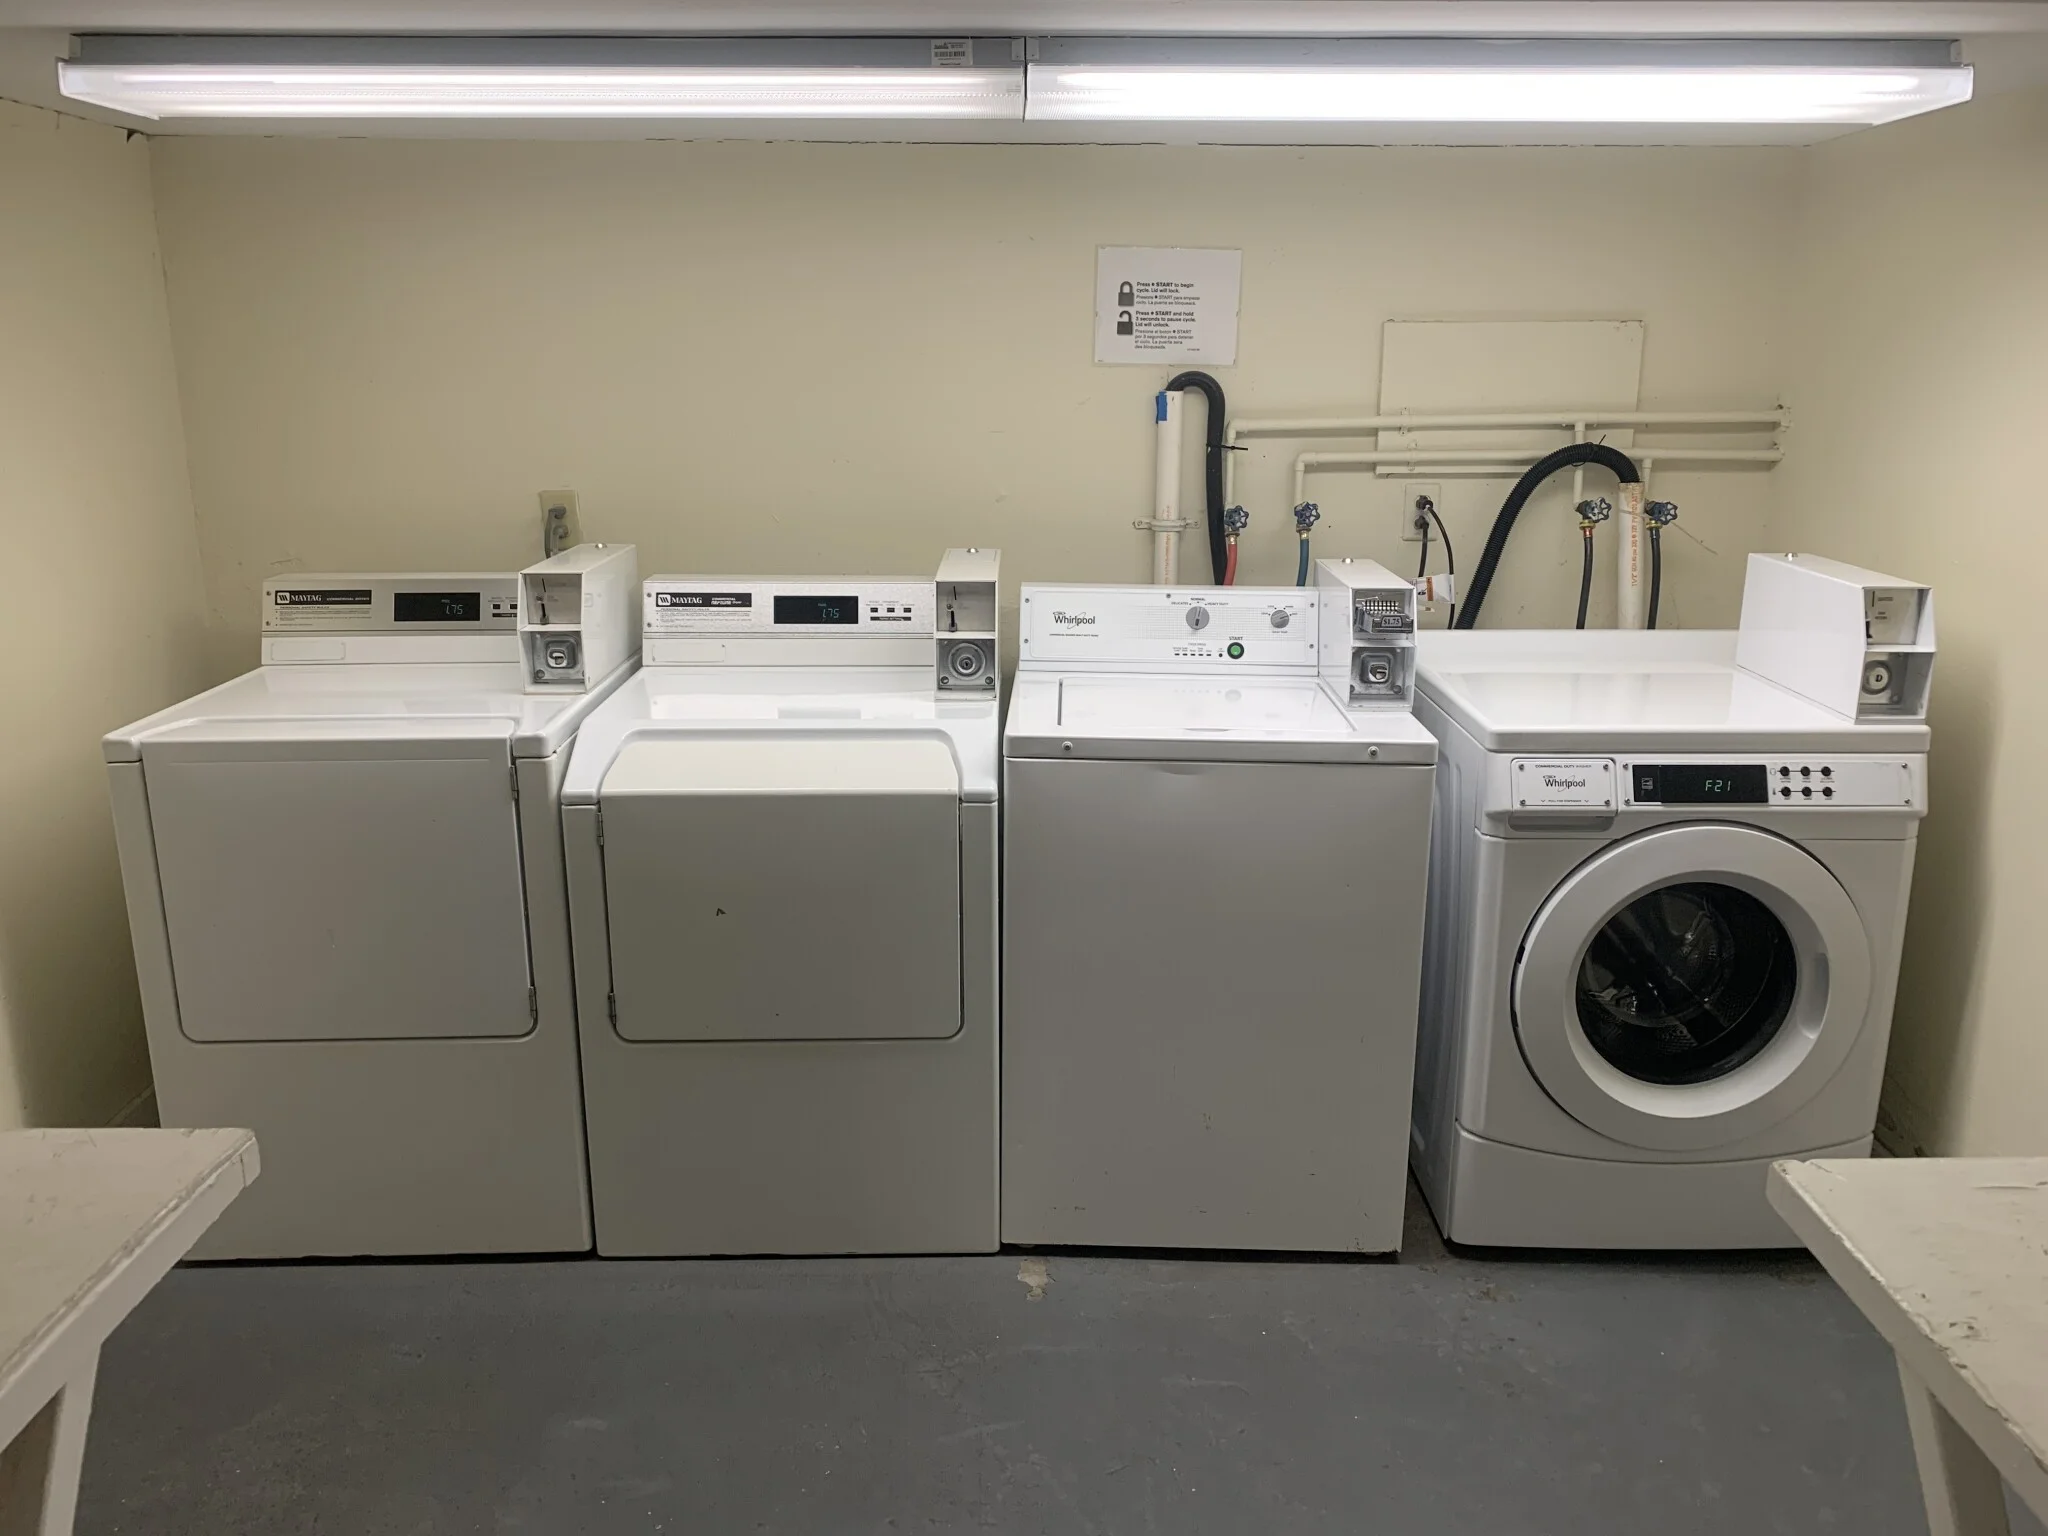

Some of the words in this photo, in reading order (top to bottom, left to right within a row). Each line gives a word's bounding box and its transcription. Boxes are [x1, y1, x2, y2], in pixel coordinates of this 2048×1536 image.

[1054, 616, 1096, 626] Whirlpool
[1544, 778, 1586, 789] Whirlpool
[1705, 780, 1731, 791] F21
